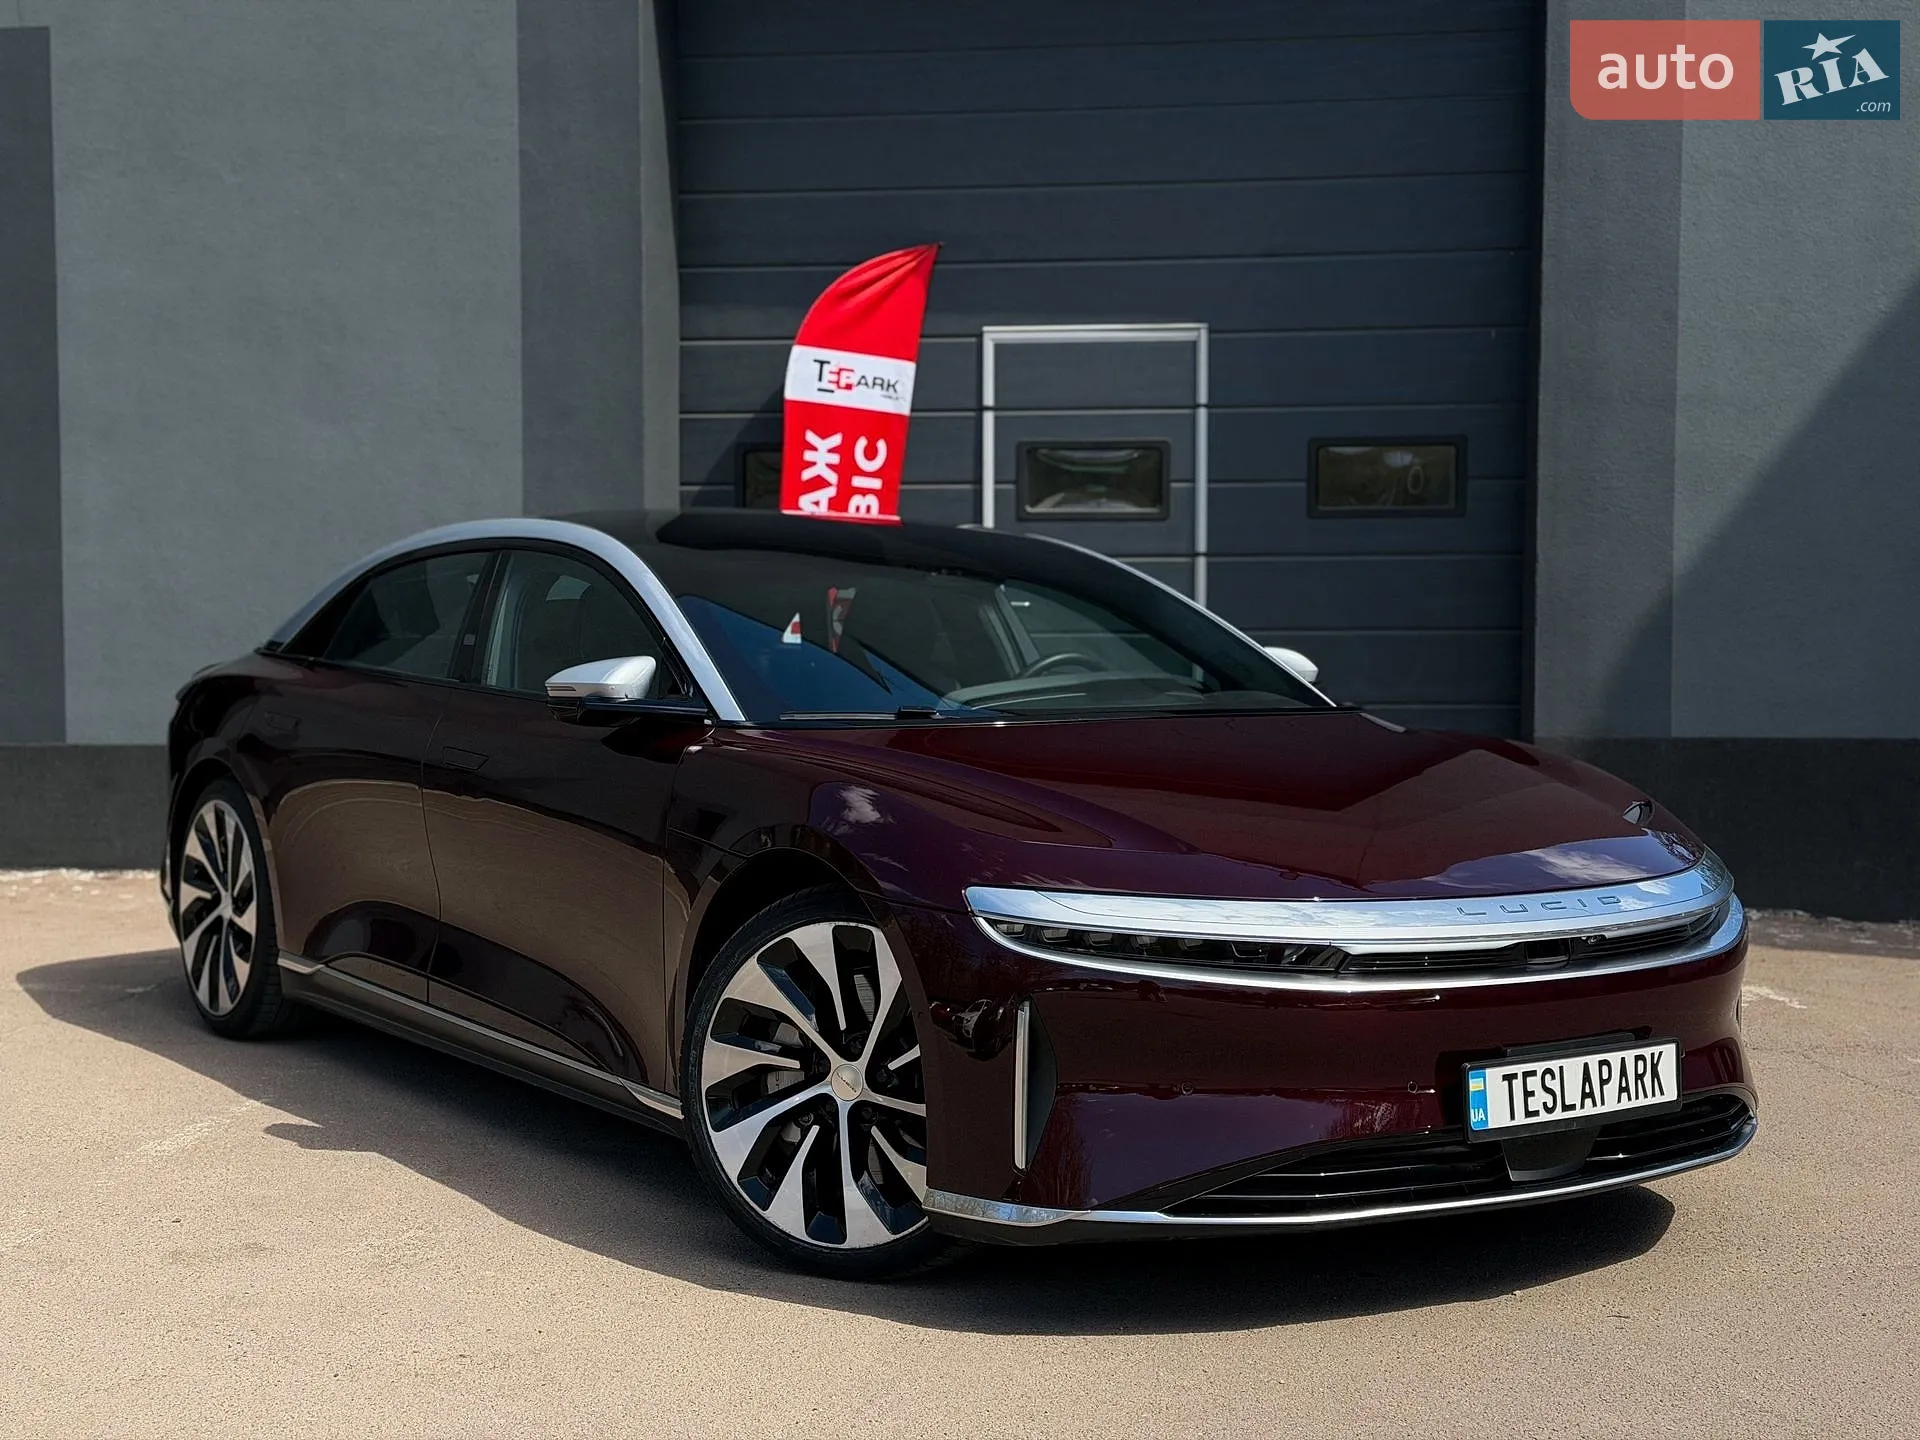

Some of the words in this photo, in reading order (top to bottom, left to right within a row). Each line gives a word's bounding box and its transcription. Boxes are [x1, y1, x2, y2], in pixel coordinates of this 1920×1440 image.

[1456, 896, 1622, 916] LUCID
[1501, 1050, 1666, 1122] TESLAPARK
[1471, 1107, 1487, 1122] UA
